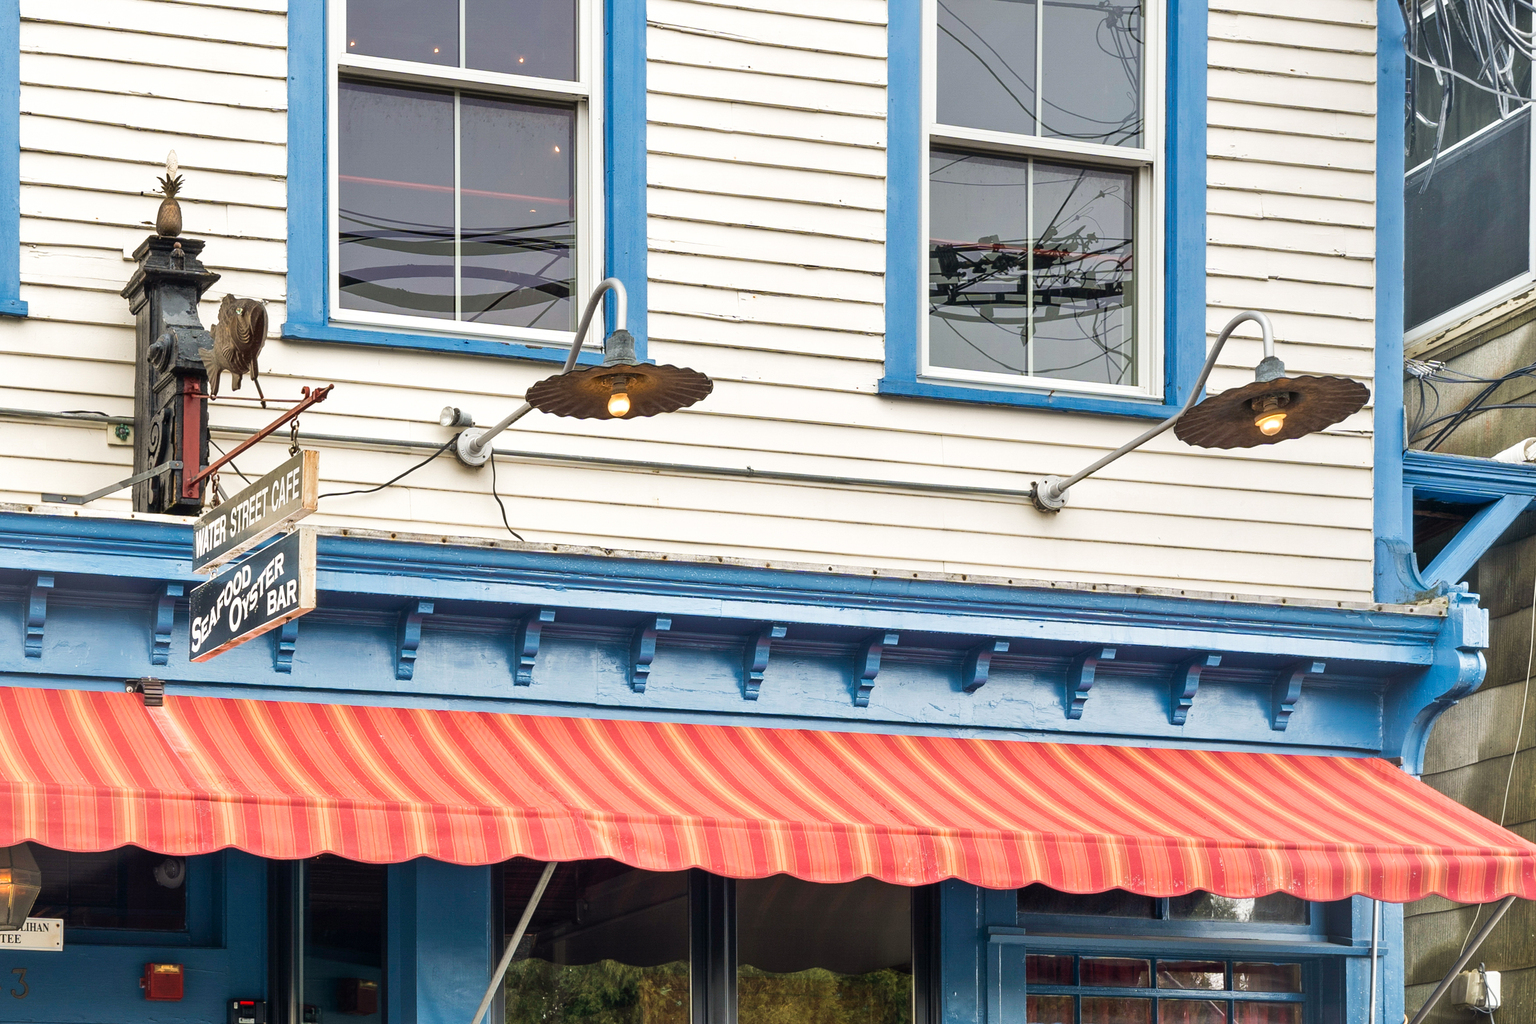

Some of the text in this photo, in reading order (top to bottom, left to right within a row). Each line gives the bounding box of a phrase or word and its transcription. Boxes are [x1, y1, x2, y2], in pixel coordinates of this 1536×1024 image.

[195, 466, 300, 560] WATER STREET CAFE
[191, 564, 252, 653] SEAFOOD
[228, 552, 285, 633] OYSTER
[267, 578, 297, 617] BAR
